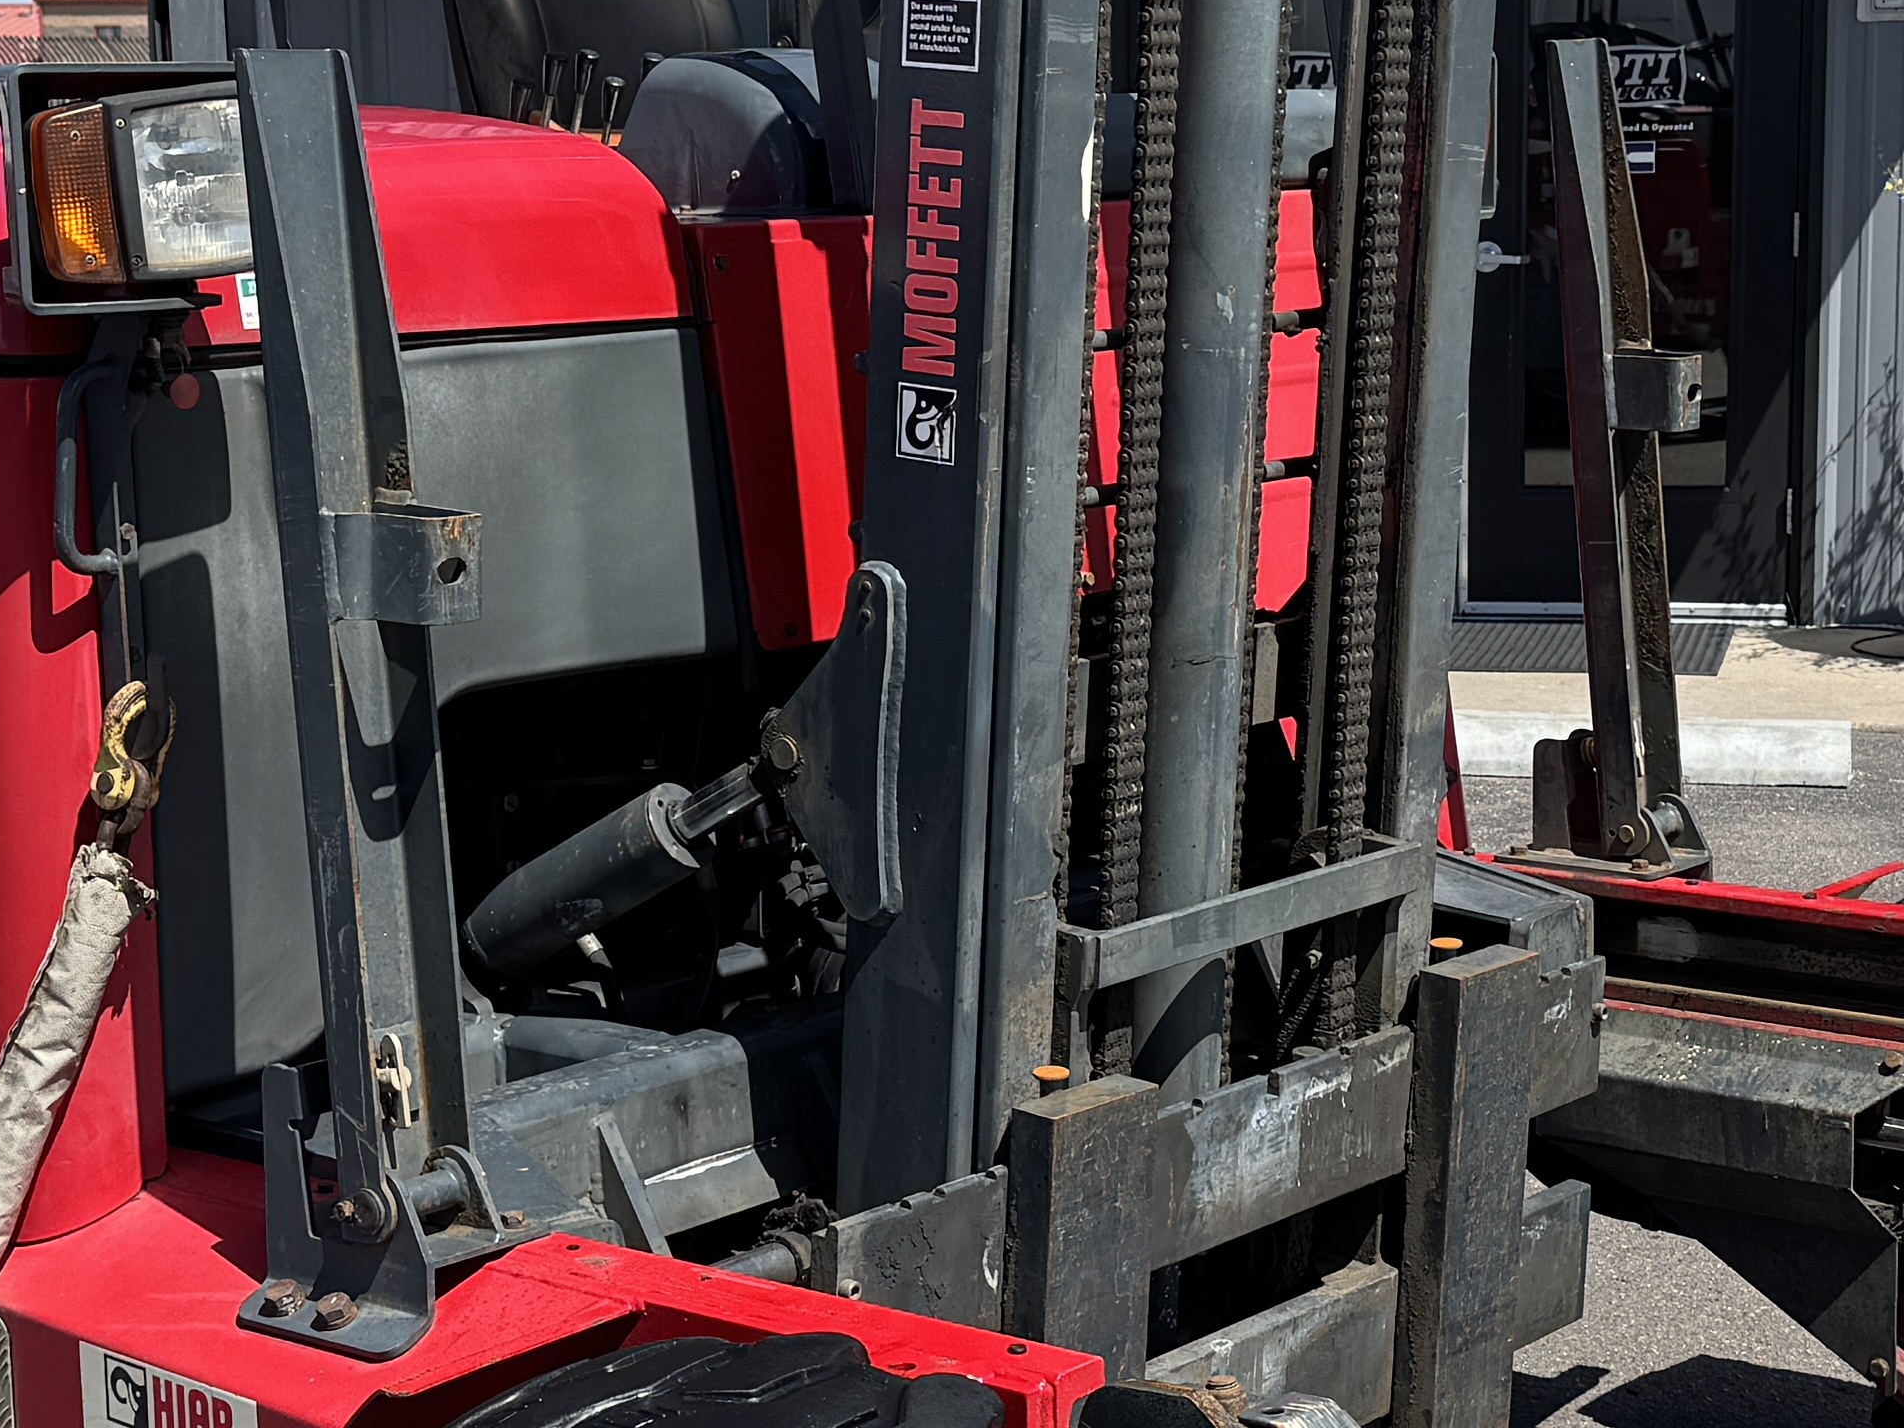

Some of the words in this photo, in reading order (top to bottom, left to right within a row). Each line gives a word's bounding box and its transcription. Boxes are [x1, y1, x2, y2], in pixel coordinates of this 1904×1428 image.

[1616, 85, 1674, 101] UCKS
[1622, 122, 1640, 132] ned
[1651, 121, 1694, 133] Operated
[901, 98, 965, 378] MOFFETT
